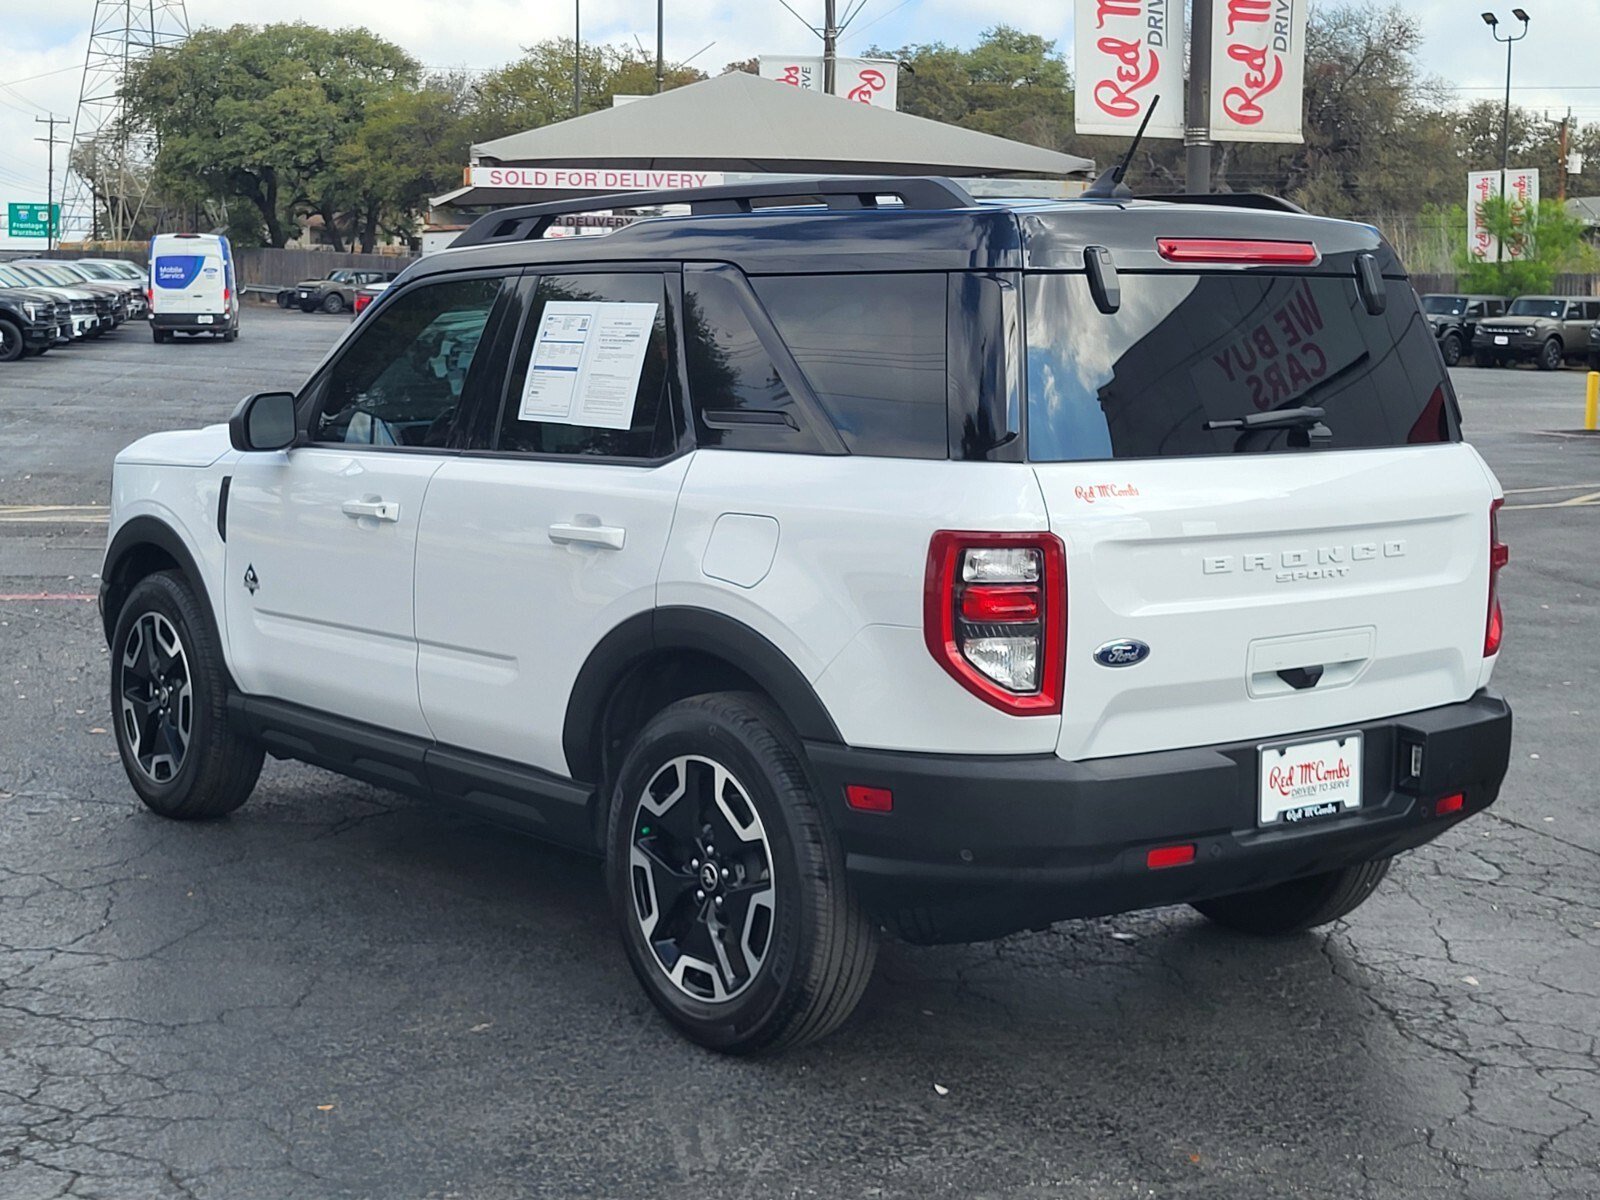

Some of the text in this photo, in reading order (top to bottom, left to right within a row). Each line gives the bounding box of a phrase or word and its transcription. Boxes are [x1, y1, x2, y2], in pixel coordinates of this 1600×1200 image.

[1094, 37, 1159, 118] Red
[1222, 44, 1283, 125] Red
[490, 170, 708, 188] SOLD FOR DELIVERY
[566, 216, 634, 227] DELIVERY
[1074, 484, 1140, 503] Red McCombs
[1202, 540, 1406, 575] BRONCO
[1276, 567, 1350, 583] SPORT
[1269, 758, 1351, 796] Red McCombs
[1291, 779, 1350, 797] DRIVEN TO SERVE
[1286, 808, 1303, 822] Red
